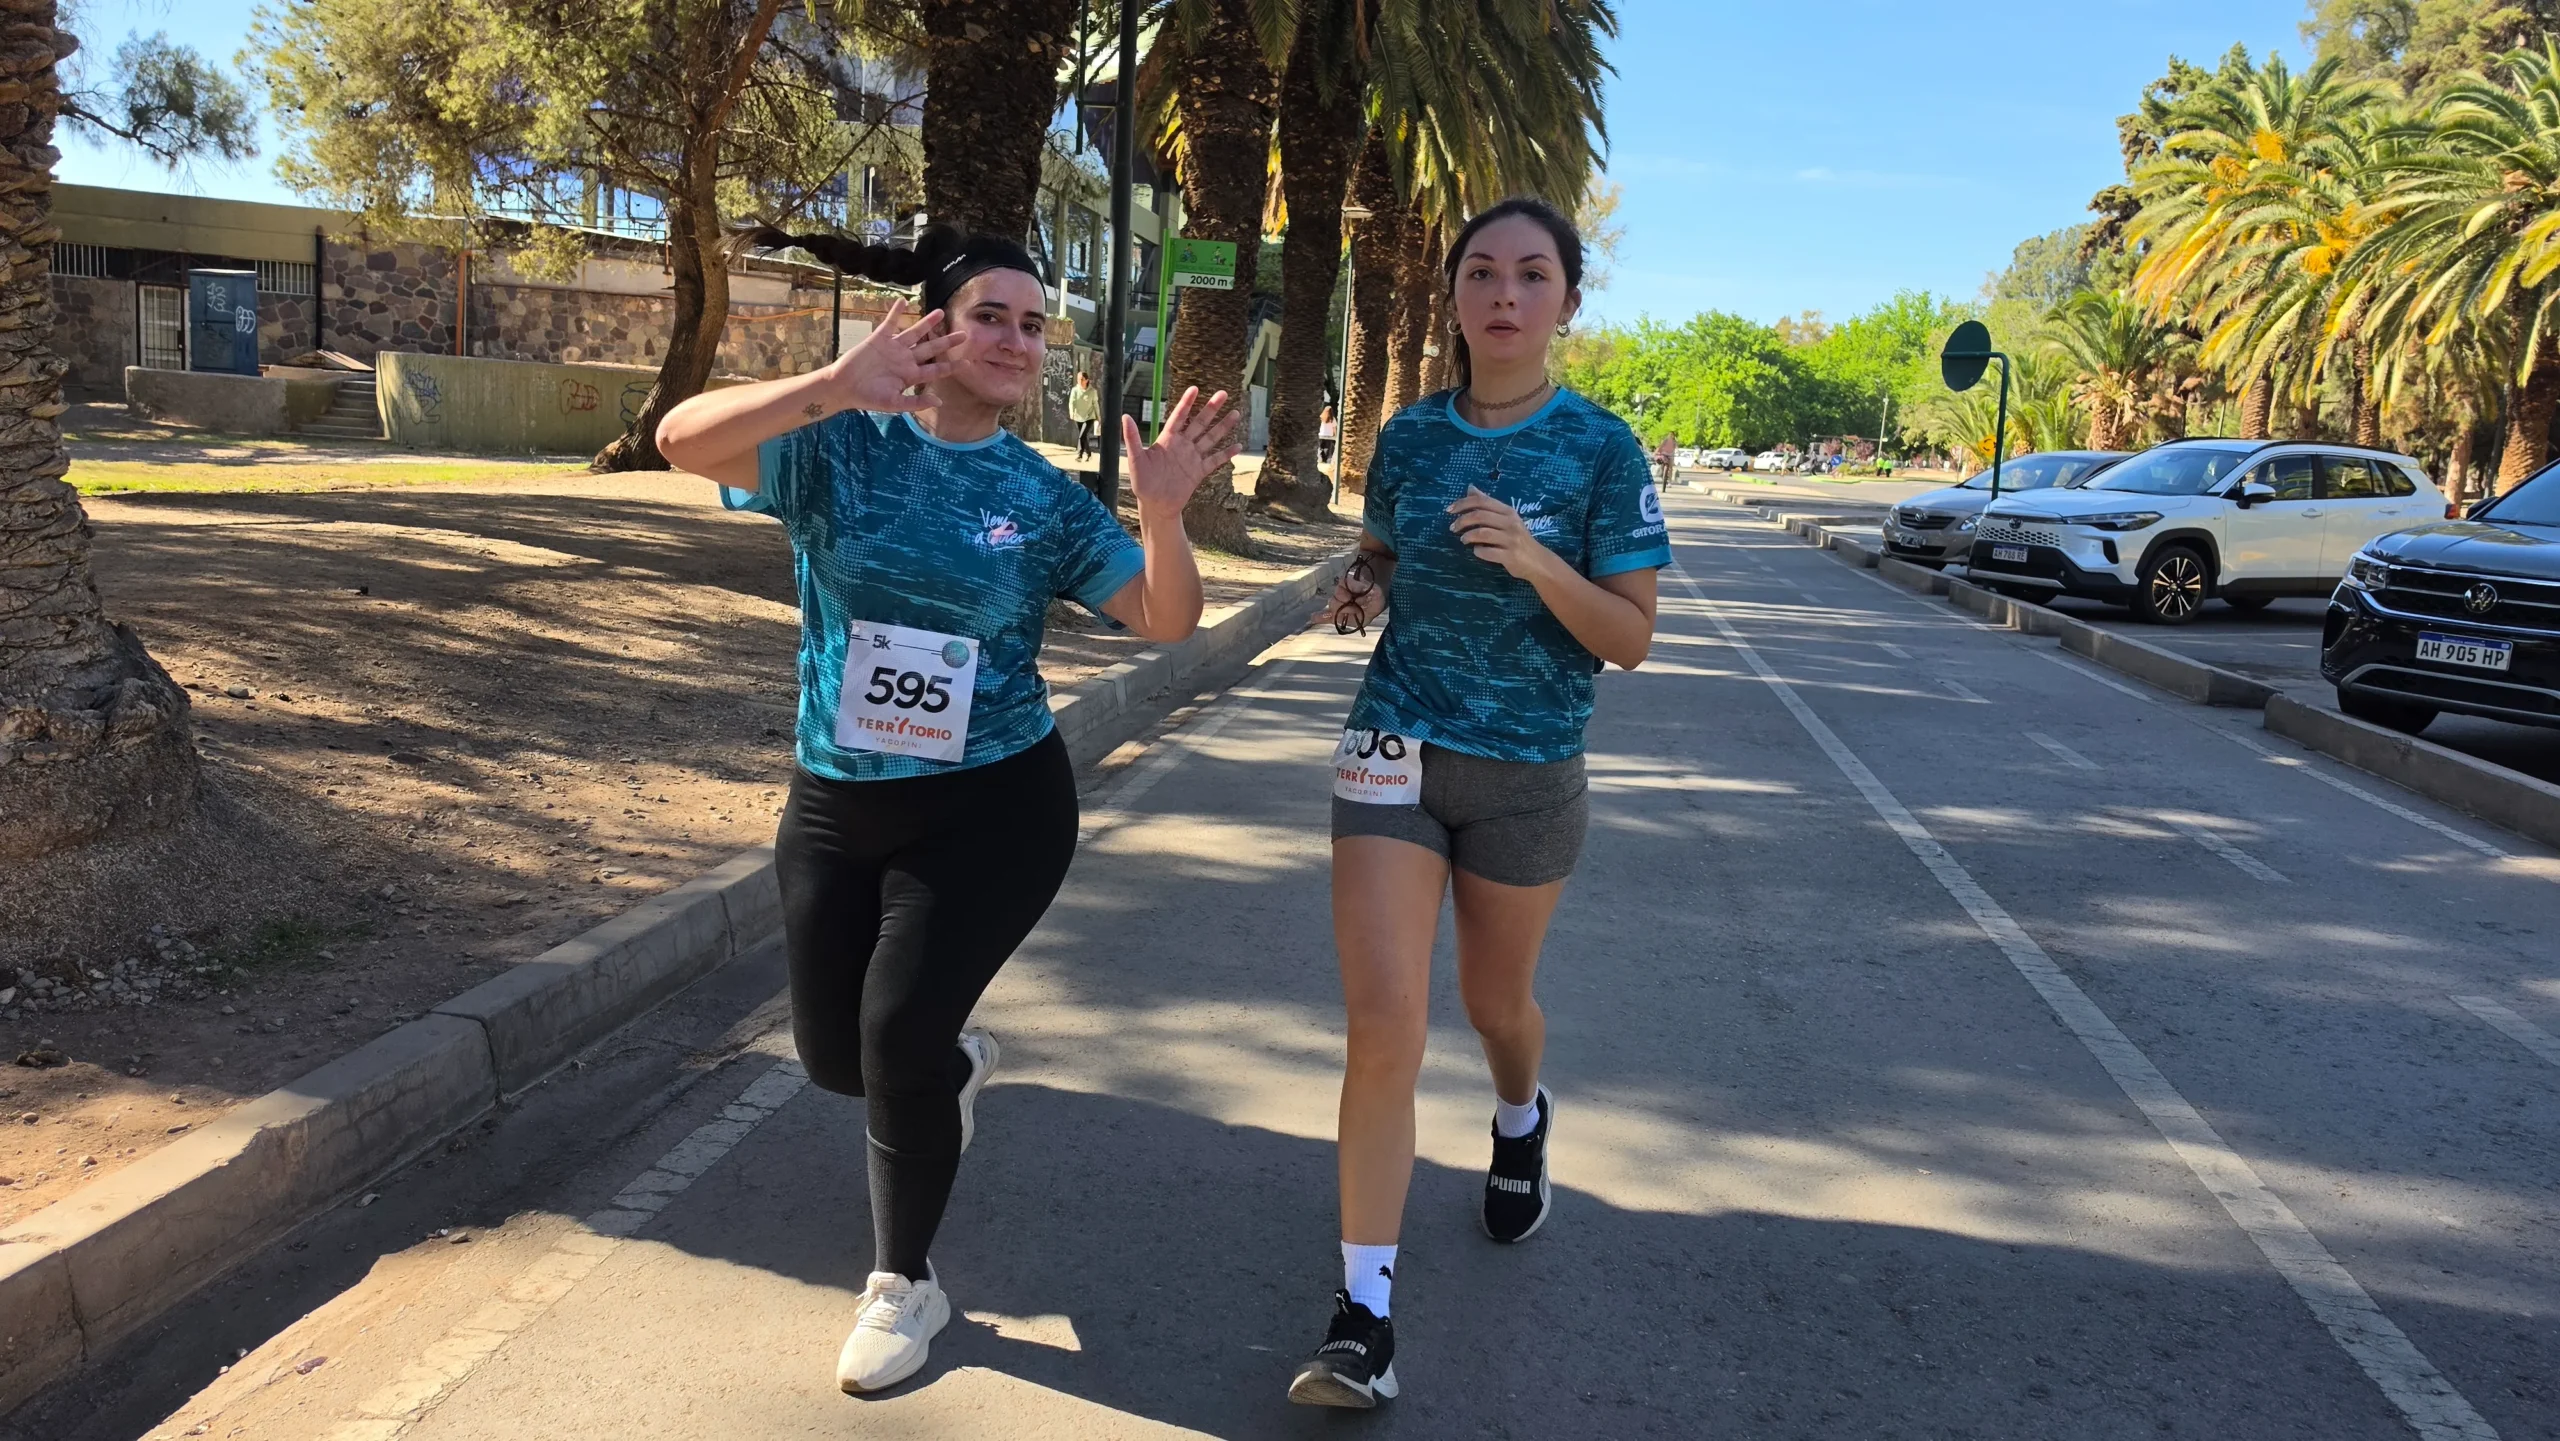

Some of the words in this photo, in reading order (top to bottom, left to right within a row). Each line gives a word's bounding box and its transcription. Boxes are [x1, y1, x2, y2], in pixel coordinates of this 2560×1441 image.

[1190, 275, 1216, 286] 2000
[1217, 279, 1228, 287] m
[2420, 641, 2441, 658] AH
[2446, 645, 2478, 662] 905
[2482, 649, 2504, 666] HP
[864, 666, 953, 713] 595
[857, 716, 952, 740] TERRITORIO
[876, 737, 922, 749] YACOPINI
[1336, 766, 1408, 785] TERRITORIO
[1345, 786, 1383, 797] YACOPINI
[1490, 1174, 1531, 1194] PUMA
[1317, 1339, 1367, 1356] PUMA
